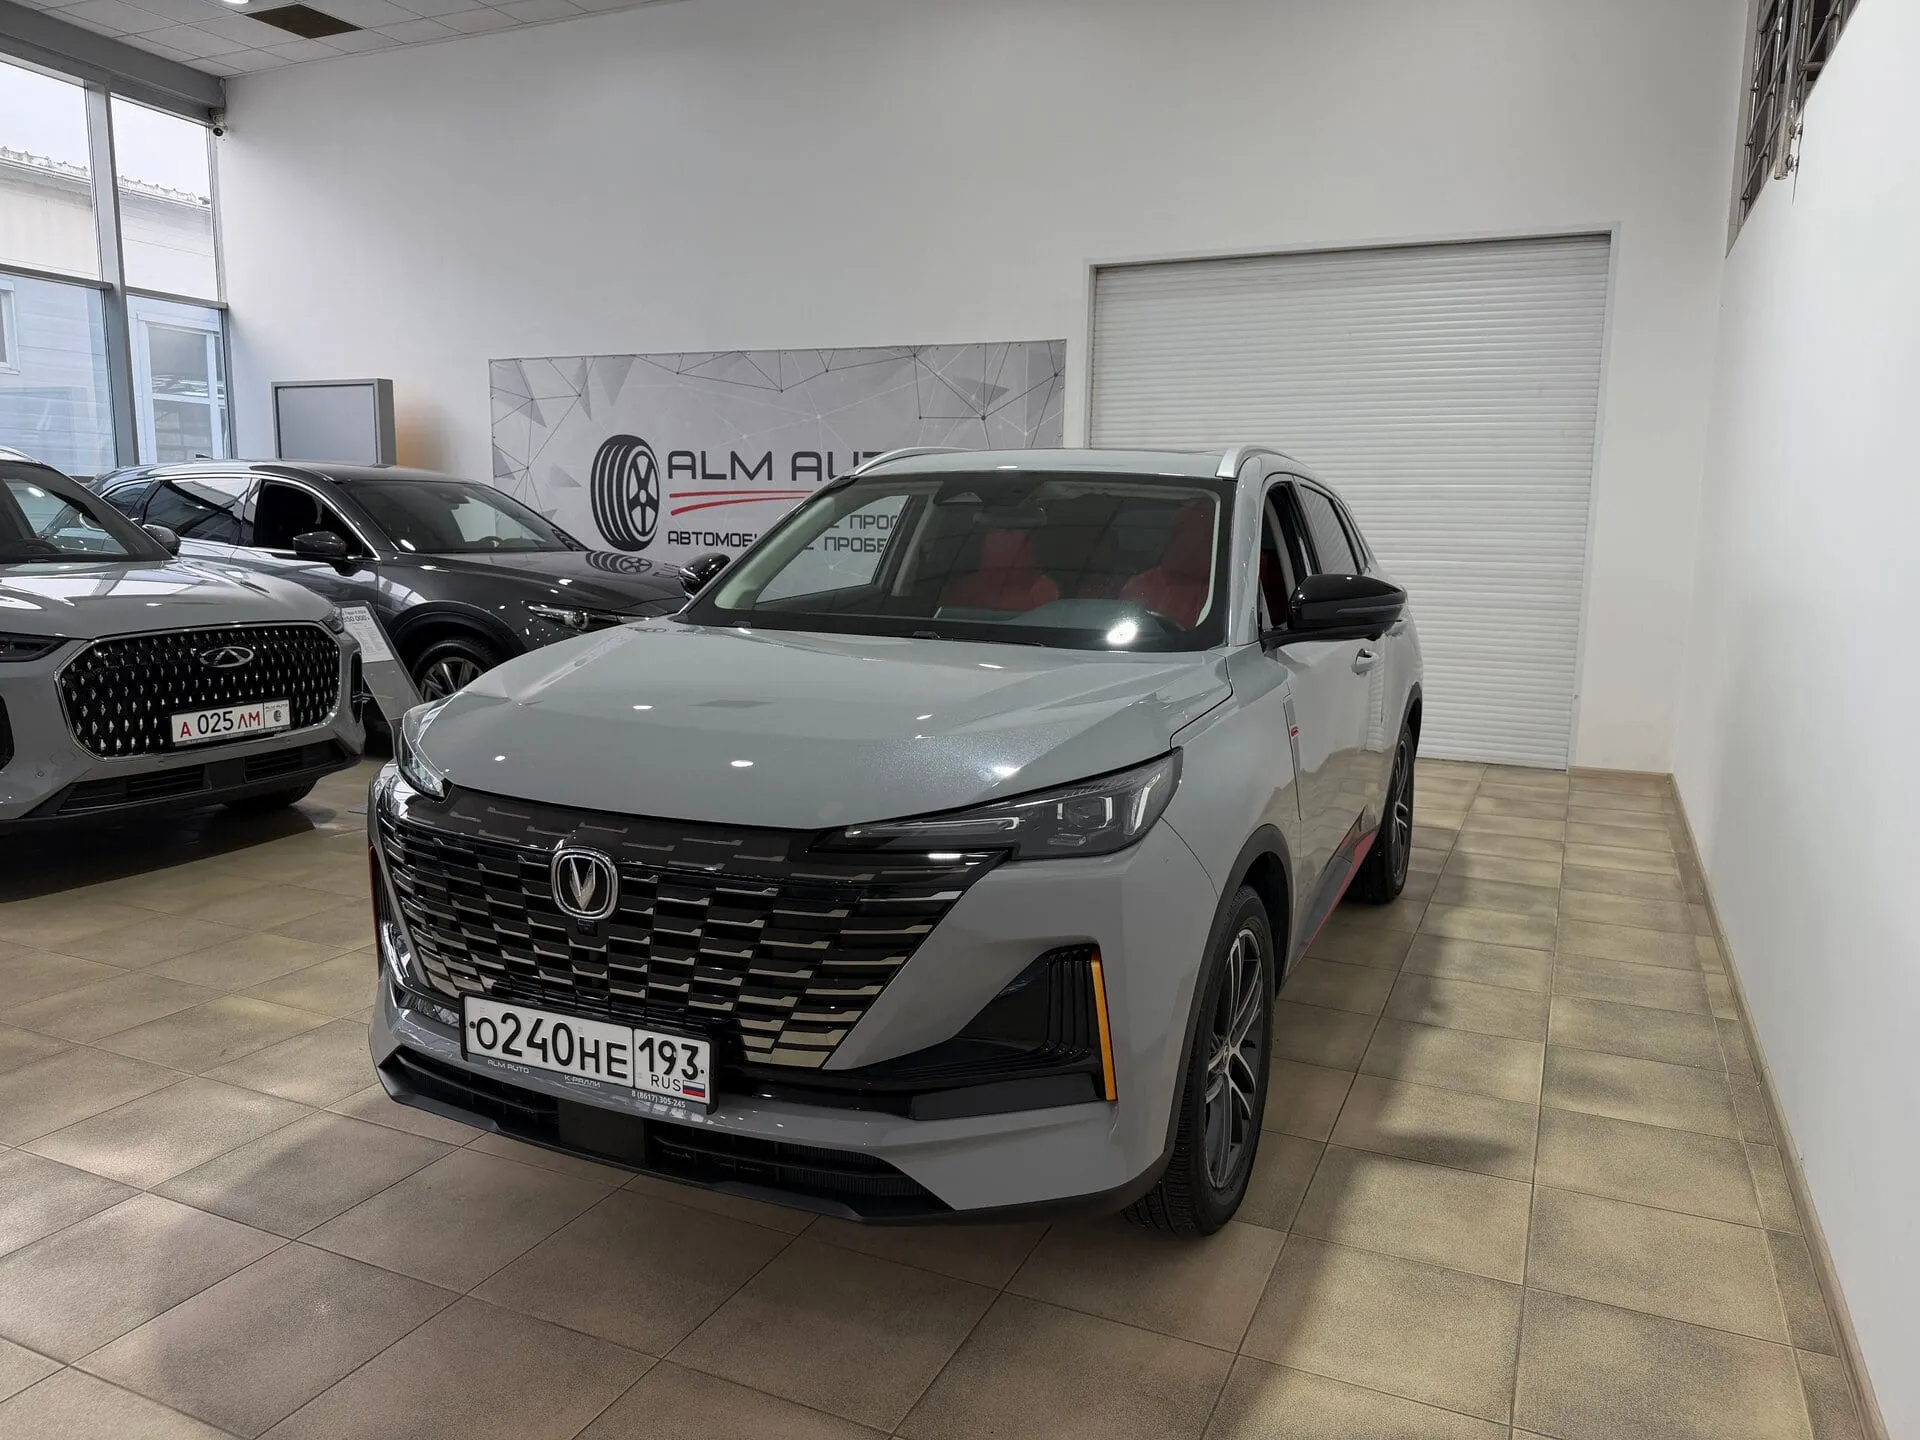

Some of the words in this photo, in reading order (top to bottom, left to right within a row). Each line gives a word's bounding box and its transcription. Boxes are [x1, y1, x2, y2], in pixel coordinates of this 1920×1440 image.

[667, 450, 773, 480] ALM
[667, 530, 757, 547] АВТОМОБ
[197, 710, 234, 735] 025
[487, 1059, 506, 1070] ALM
[507, 1063, 530, 1074] AUTO
[638, 1036, 700, 1081] 193
[650, 1074, 682, 1092] RUS
